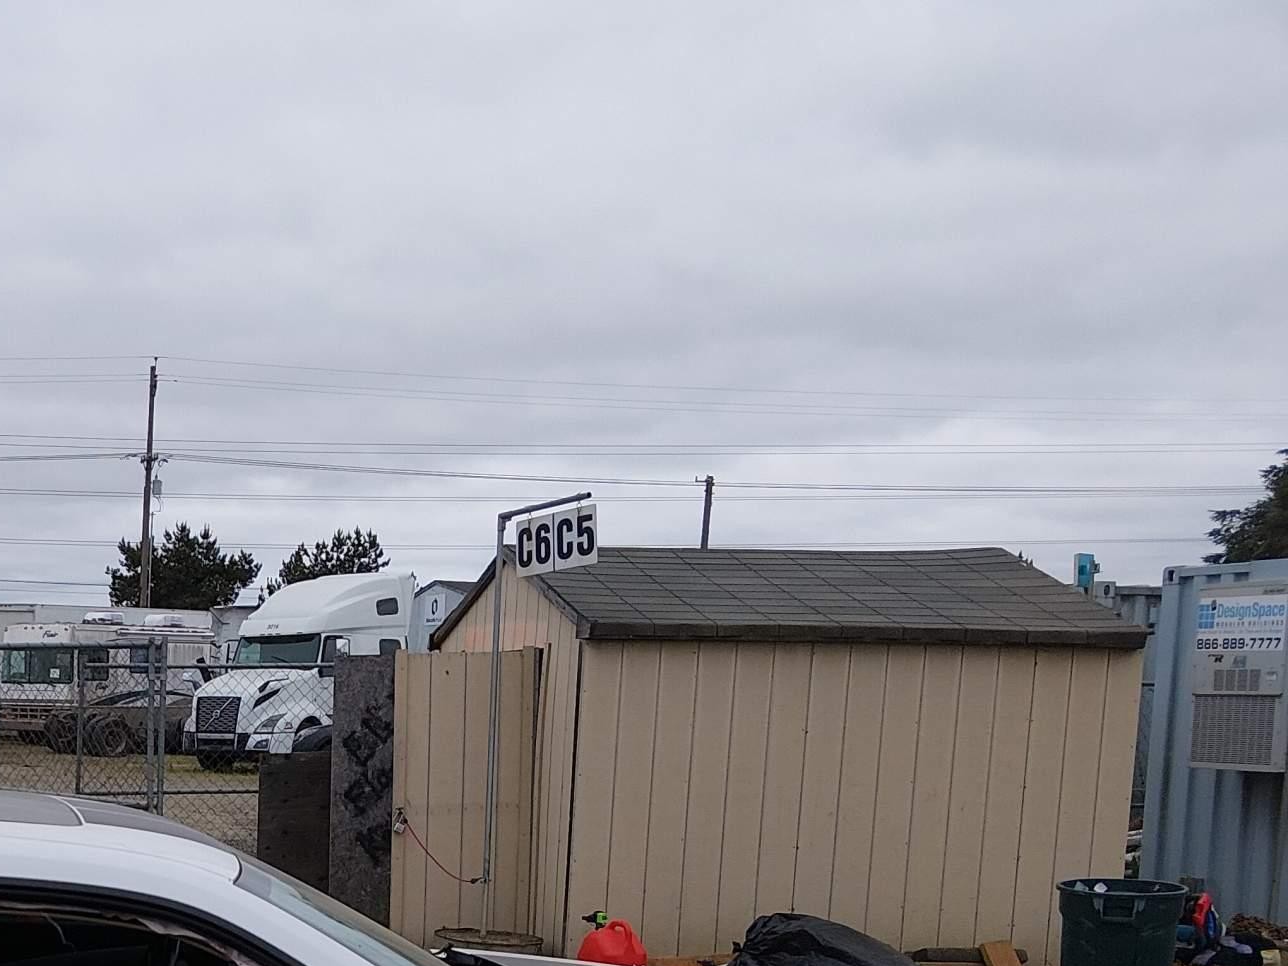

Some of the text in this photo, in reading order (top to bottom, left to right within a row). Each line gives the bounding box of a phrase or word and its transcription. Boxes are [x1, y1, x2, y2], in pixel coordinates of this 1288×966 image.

[518, 523, 551, 568] C6
[556, 514, 594, 559] C5
[1217, 602, 1285, 620] DesignSpace
